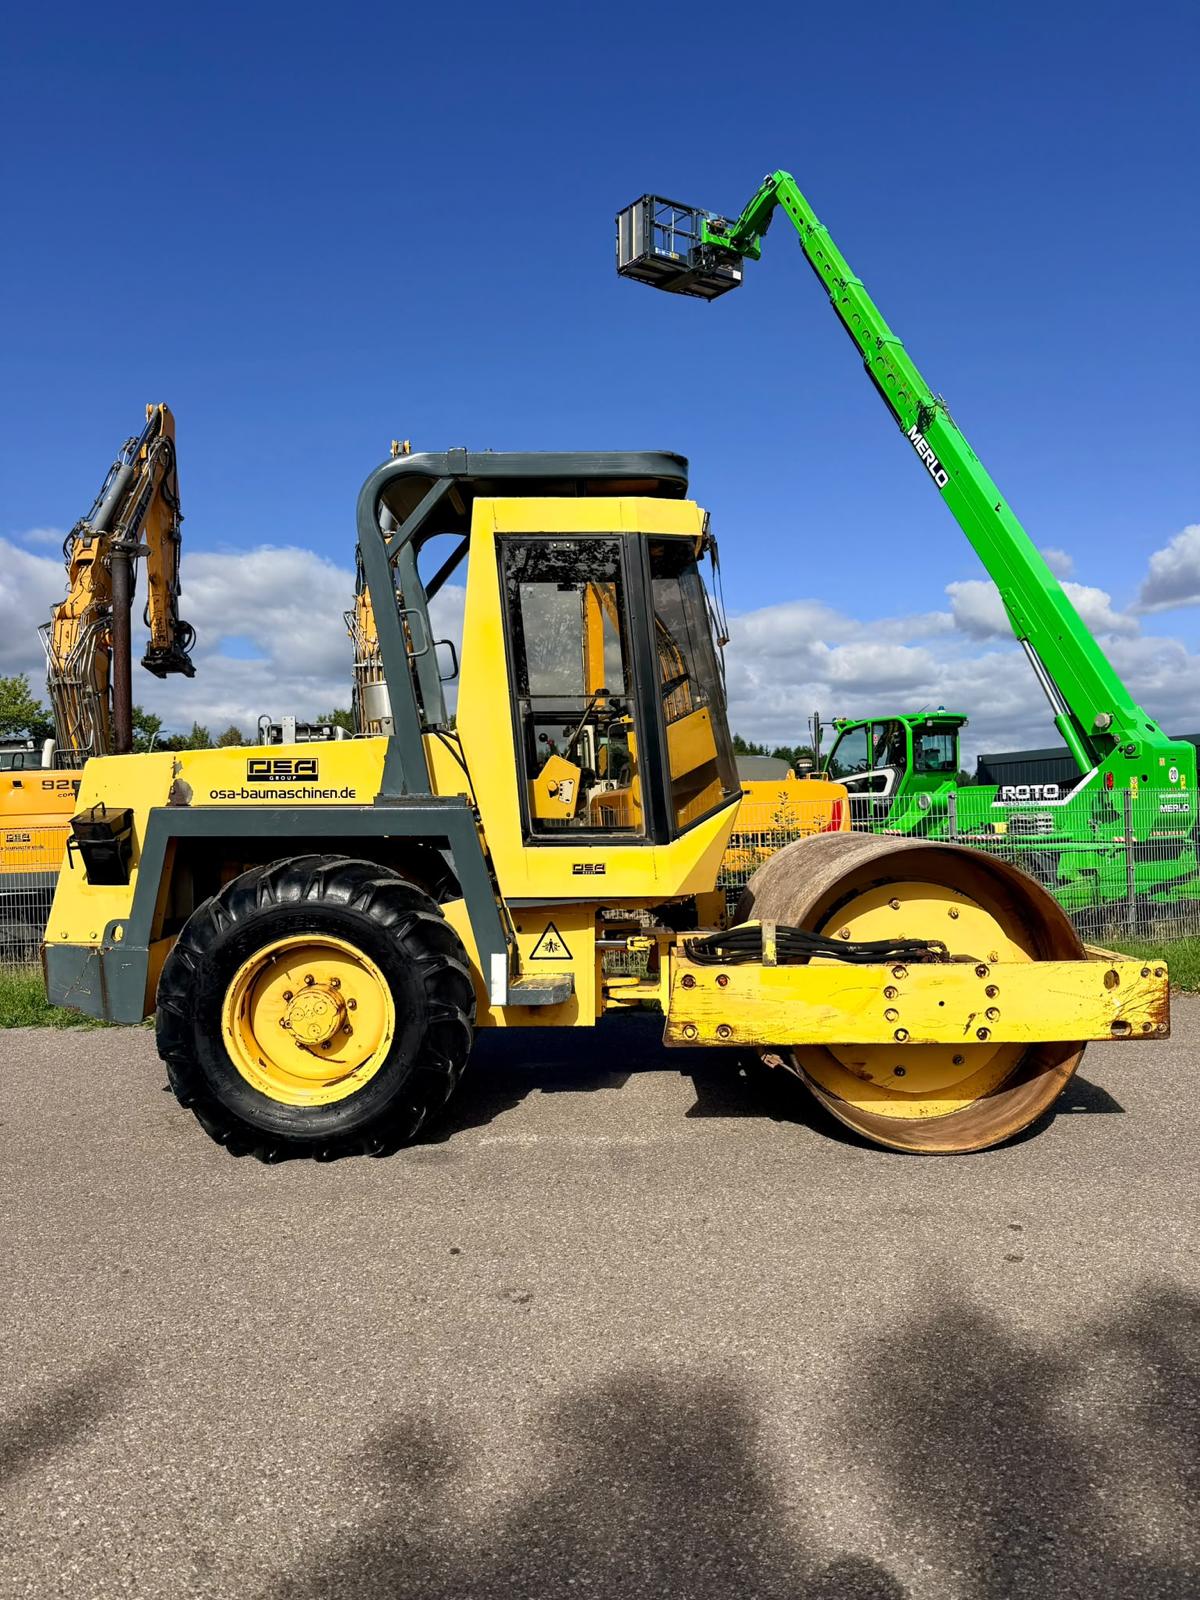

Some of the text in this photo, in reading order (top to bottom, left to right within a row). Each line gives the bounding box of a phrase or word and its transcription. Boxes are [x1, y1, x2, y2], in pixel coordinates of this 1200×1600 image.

[907, 424, 949, 488] MERLO
[249, 760, 316, 774] OSA
[209, 787, 356, 800] osa-baumaschinen.de
[1002, 783, 1059, 800] ROTO
[1160, 803, 1190, 813] MERLO
[573, 863, 605, 871] OSA
